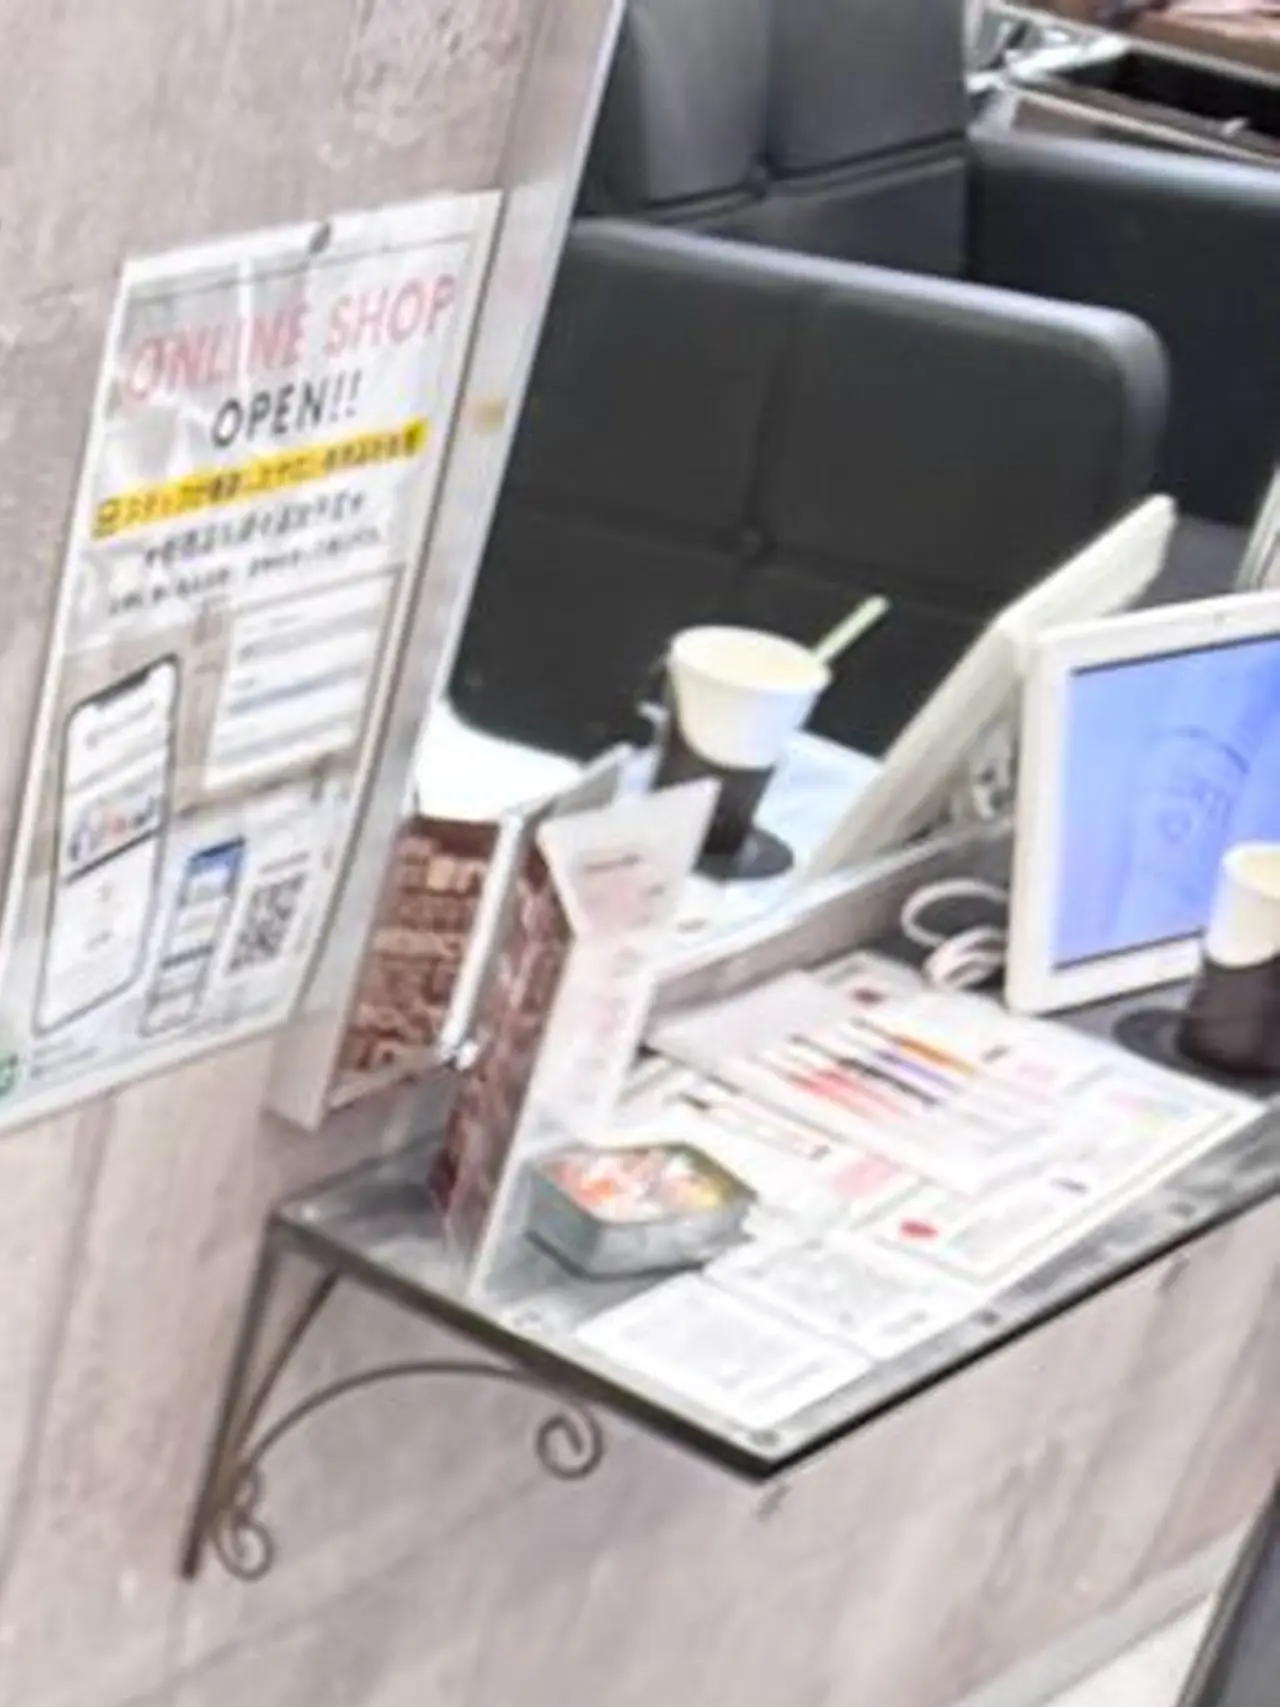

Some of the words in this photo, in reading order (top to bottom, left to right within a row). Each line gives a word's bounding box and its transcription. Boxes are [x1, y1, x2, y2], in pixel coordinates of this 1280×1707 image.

[121, 303, 310, 404] ONLINE
[324, 272, 456, 356] SHOP
[211, 368, 363, 449] OPEN!!
